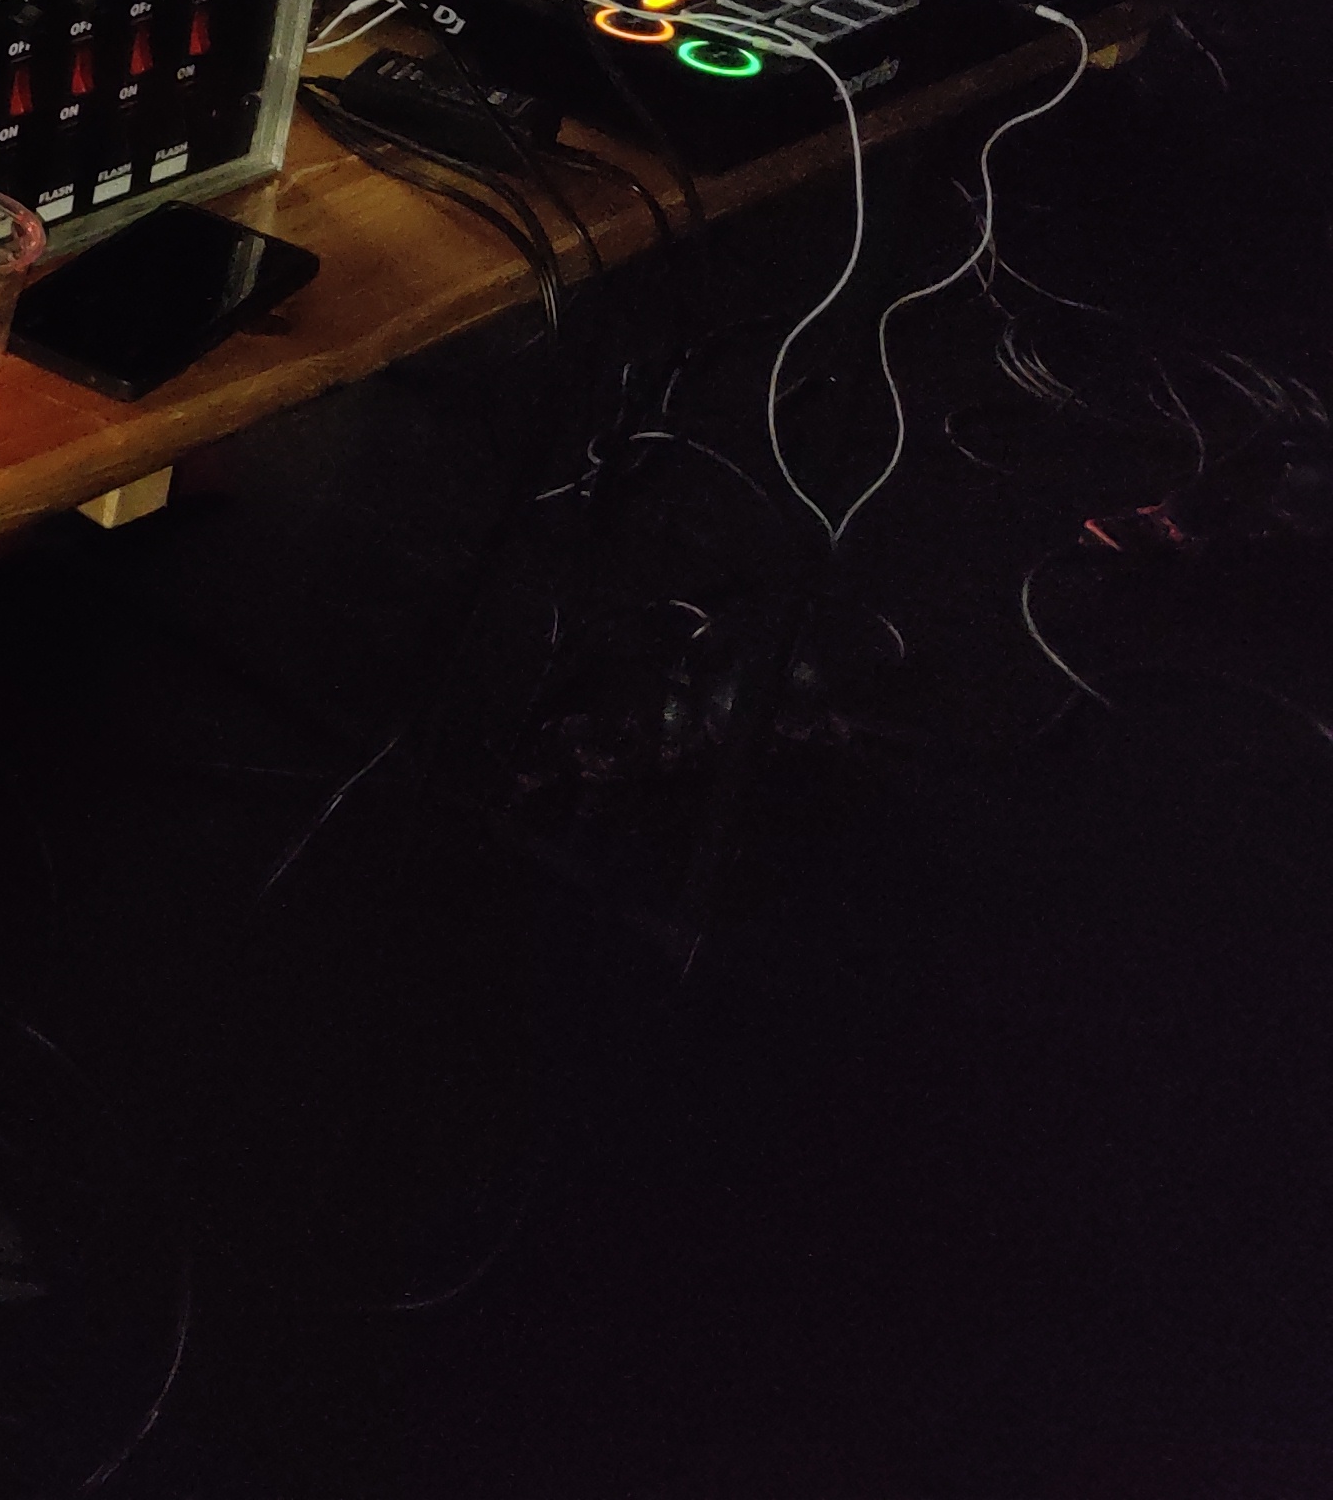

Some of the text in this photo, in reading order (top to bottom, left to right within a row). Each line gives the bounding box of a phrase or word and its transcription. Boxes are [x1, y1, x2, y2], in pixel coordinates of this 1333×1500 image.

[432, 4, 467, 35] DJ
[177, 64, 196, 80] ON
[119, 84, 138, 100] ON
[60, 104, 80, 120] ON
[155, 142, 188, 162] FLASH
[98, 163, 132, 182] FLASH
[38, 184, 74, 204] FLASH
